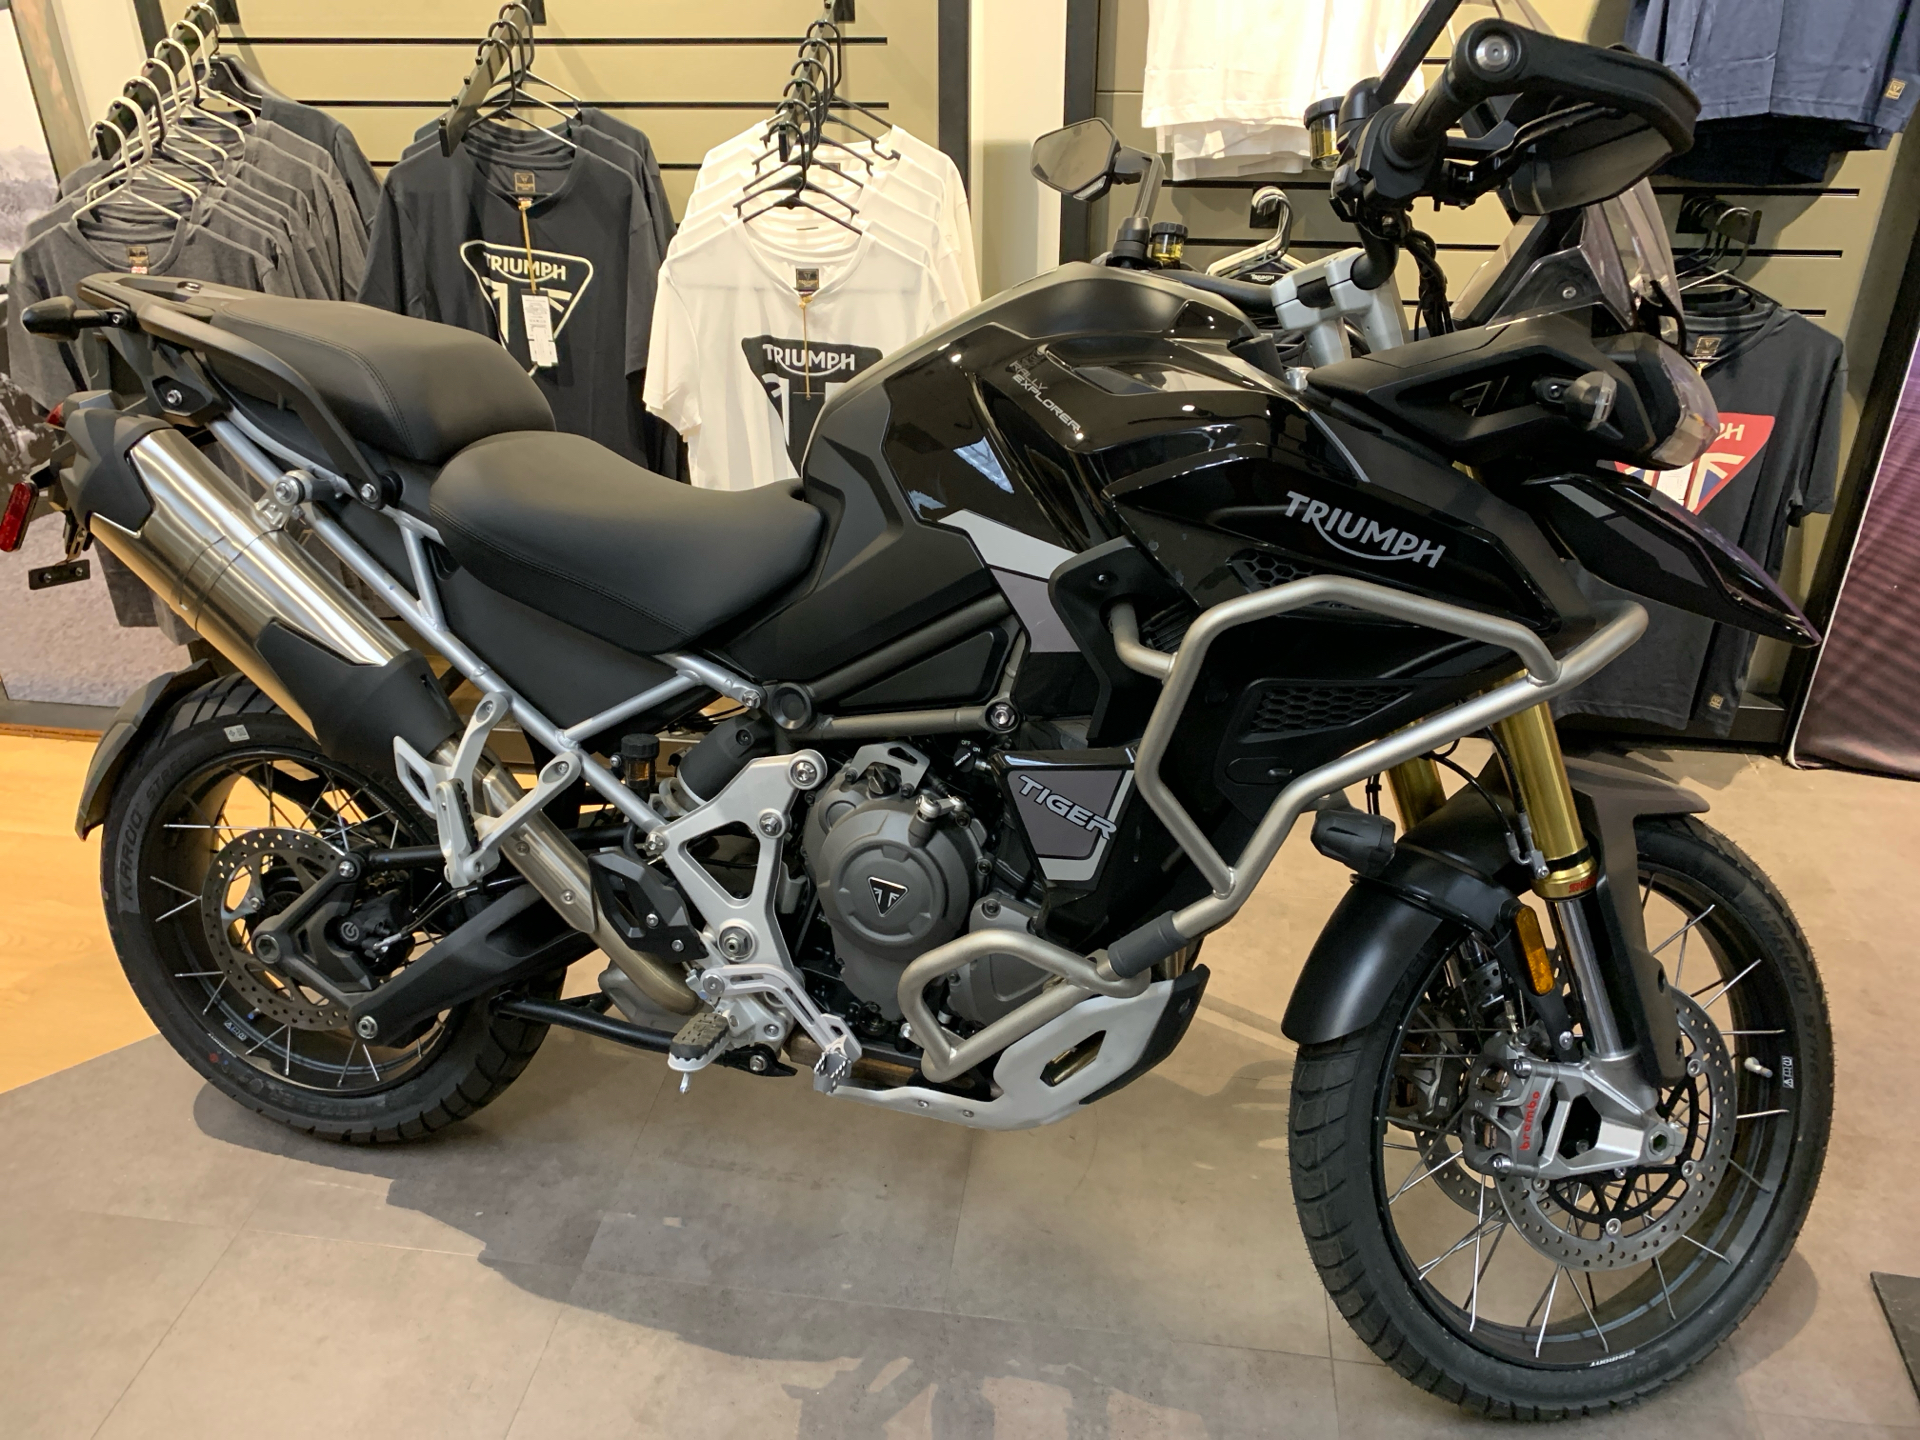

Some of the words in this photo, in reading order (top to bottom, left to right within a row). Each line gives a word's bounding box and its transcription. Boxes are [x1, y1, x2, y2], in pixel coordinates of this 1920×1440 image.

[483, 252, 566, 282] TRIUMPH
[762, 344, 855, 376] TRIUMPH
[1009, 360, 1048, 390] RALLY
[1012, 374, 1081, 434] EXPLORER
[1285, 490, 1446, 569] TRIUMPH
[1018, 774, 1117, 840] TIGER
[119, 810, 143, 901] KAROO
[1519, 1090, 1541, 1151] brembo
